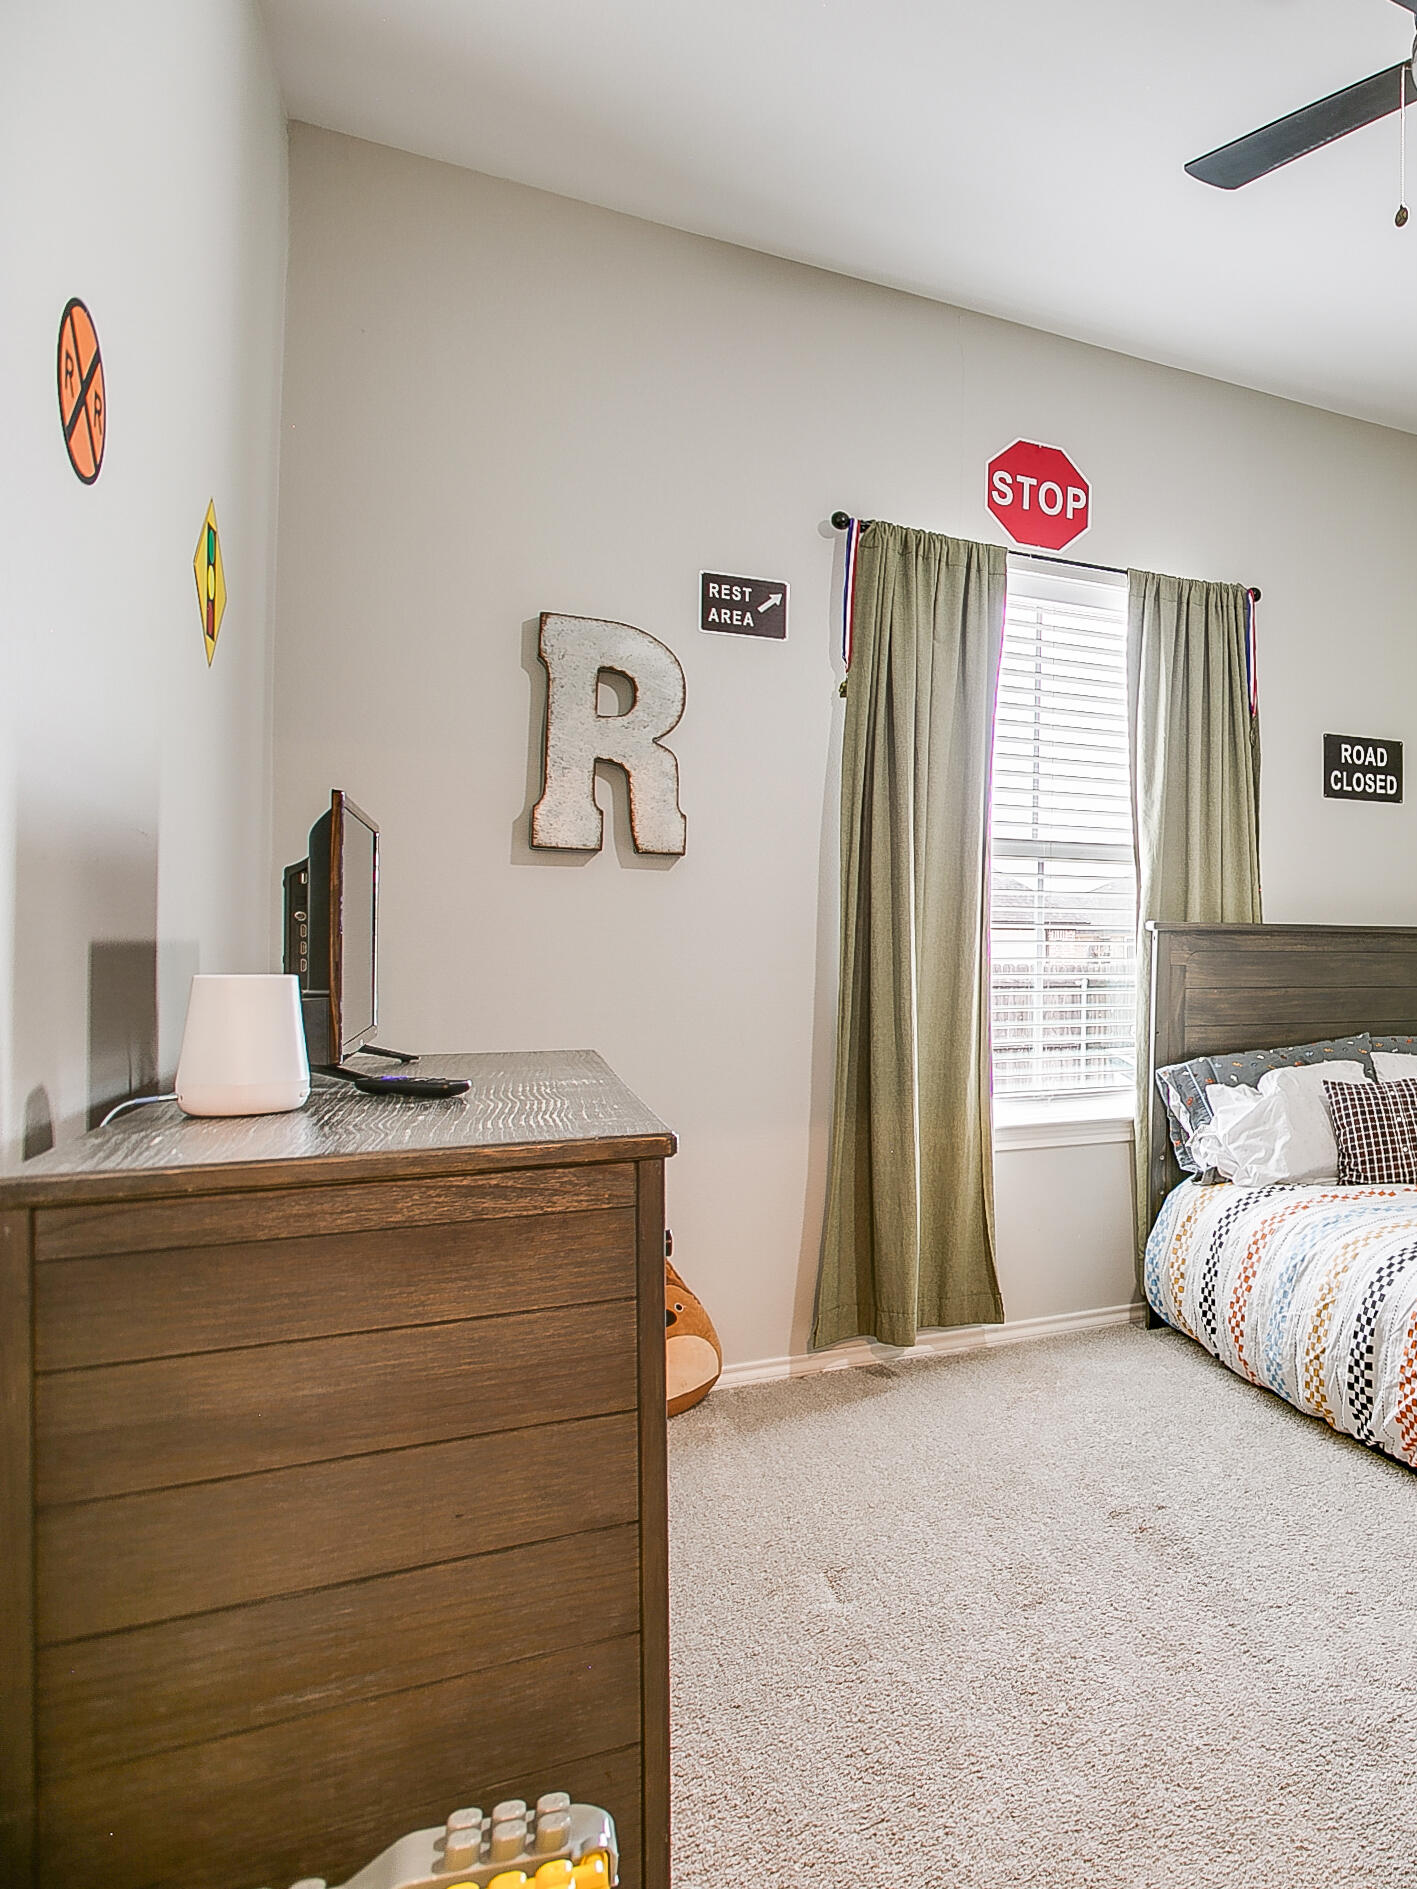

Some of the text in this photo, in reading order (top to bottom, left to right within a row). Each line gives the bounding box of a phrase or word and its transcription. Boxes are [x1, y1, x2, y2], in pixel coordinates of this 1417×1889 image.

[64, 352, 103, 436] R R
[991, 470, 1087, 520] STOP
[709, 582, 752, 602] REST
[708, 607, 754, 627] AREA
[529, 612, 687, 856] R
[1341, 743, 1388, 767] ROAD
[1330, 770, 1397, 795] CLOSED
